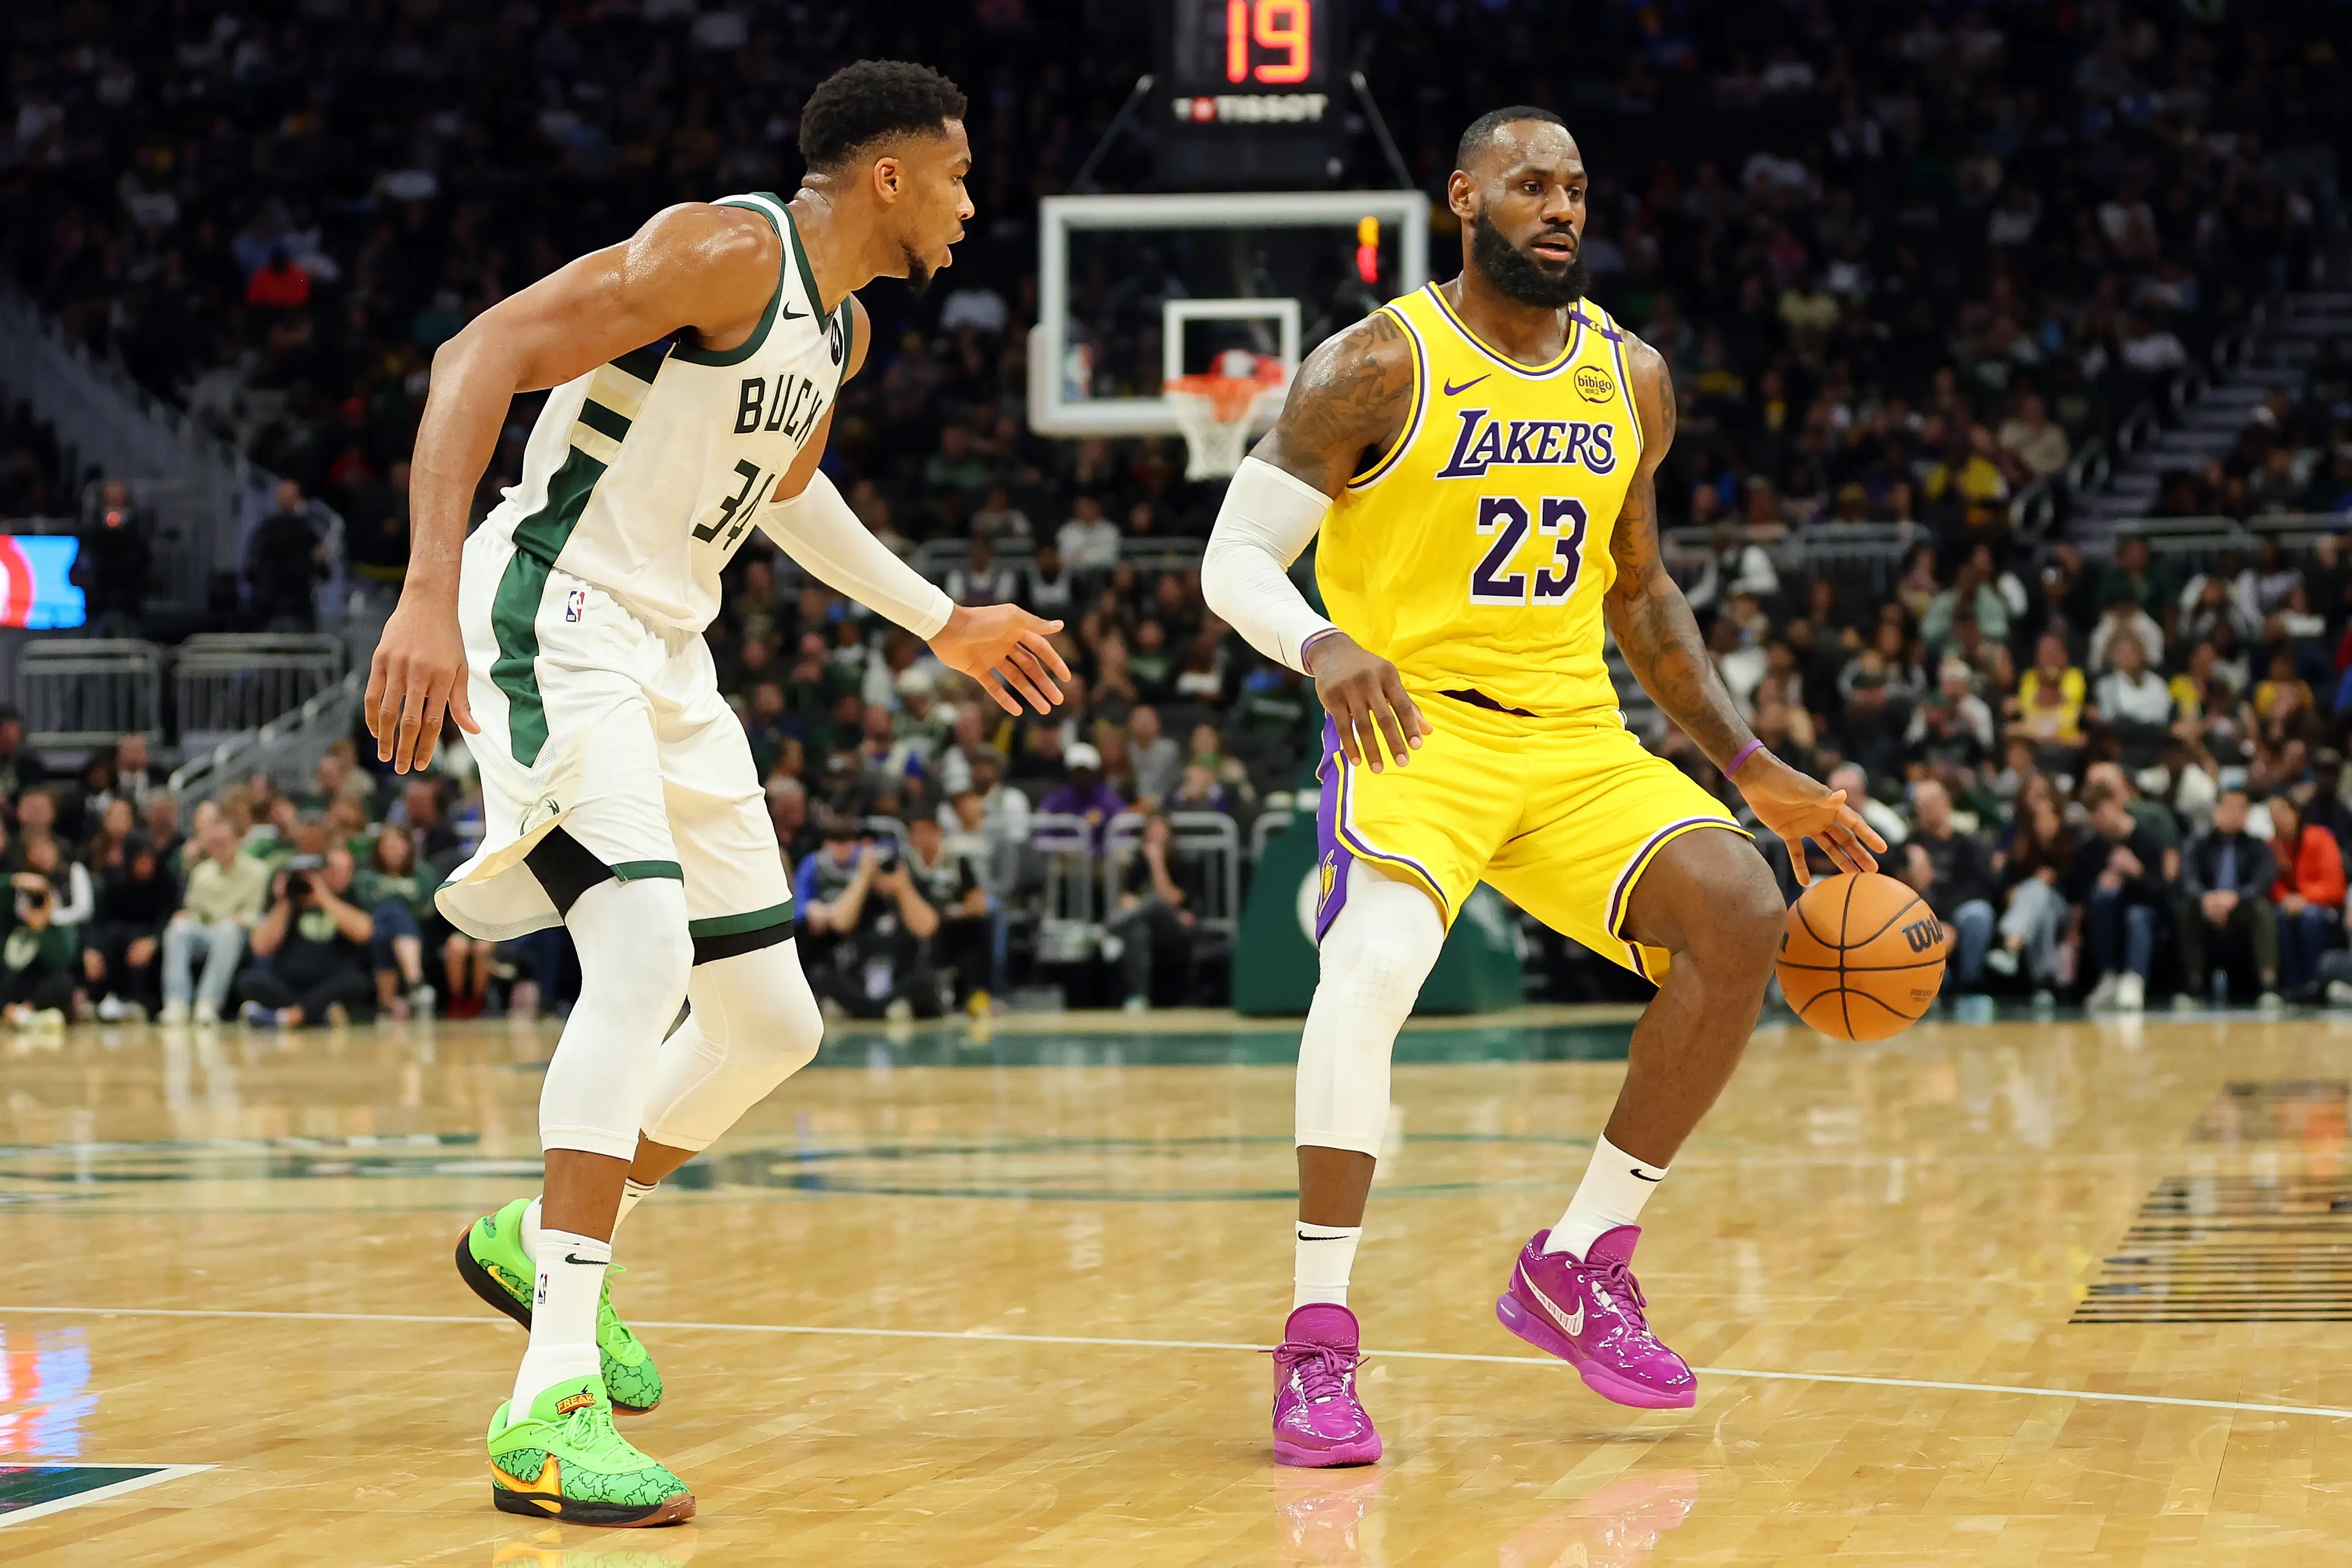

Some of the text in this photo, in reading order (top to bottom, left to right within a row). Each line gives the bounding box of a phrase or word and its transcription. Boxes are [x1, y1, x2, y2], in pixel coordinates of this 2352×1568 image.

[1226, 0, 1311, 84] 19
[1215, 94, 1329, 123] TISSOT
[1578, 375, 1612, 393] bibigo
[1434, 408, 1617, 478] LAKERS
[691, 458, 775, 551] 34
[1469, 495, 1590, 606] 23
[556, 1393, 595, 1412] FREAK
